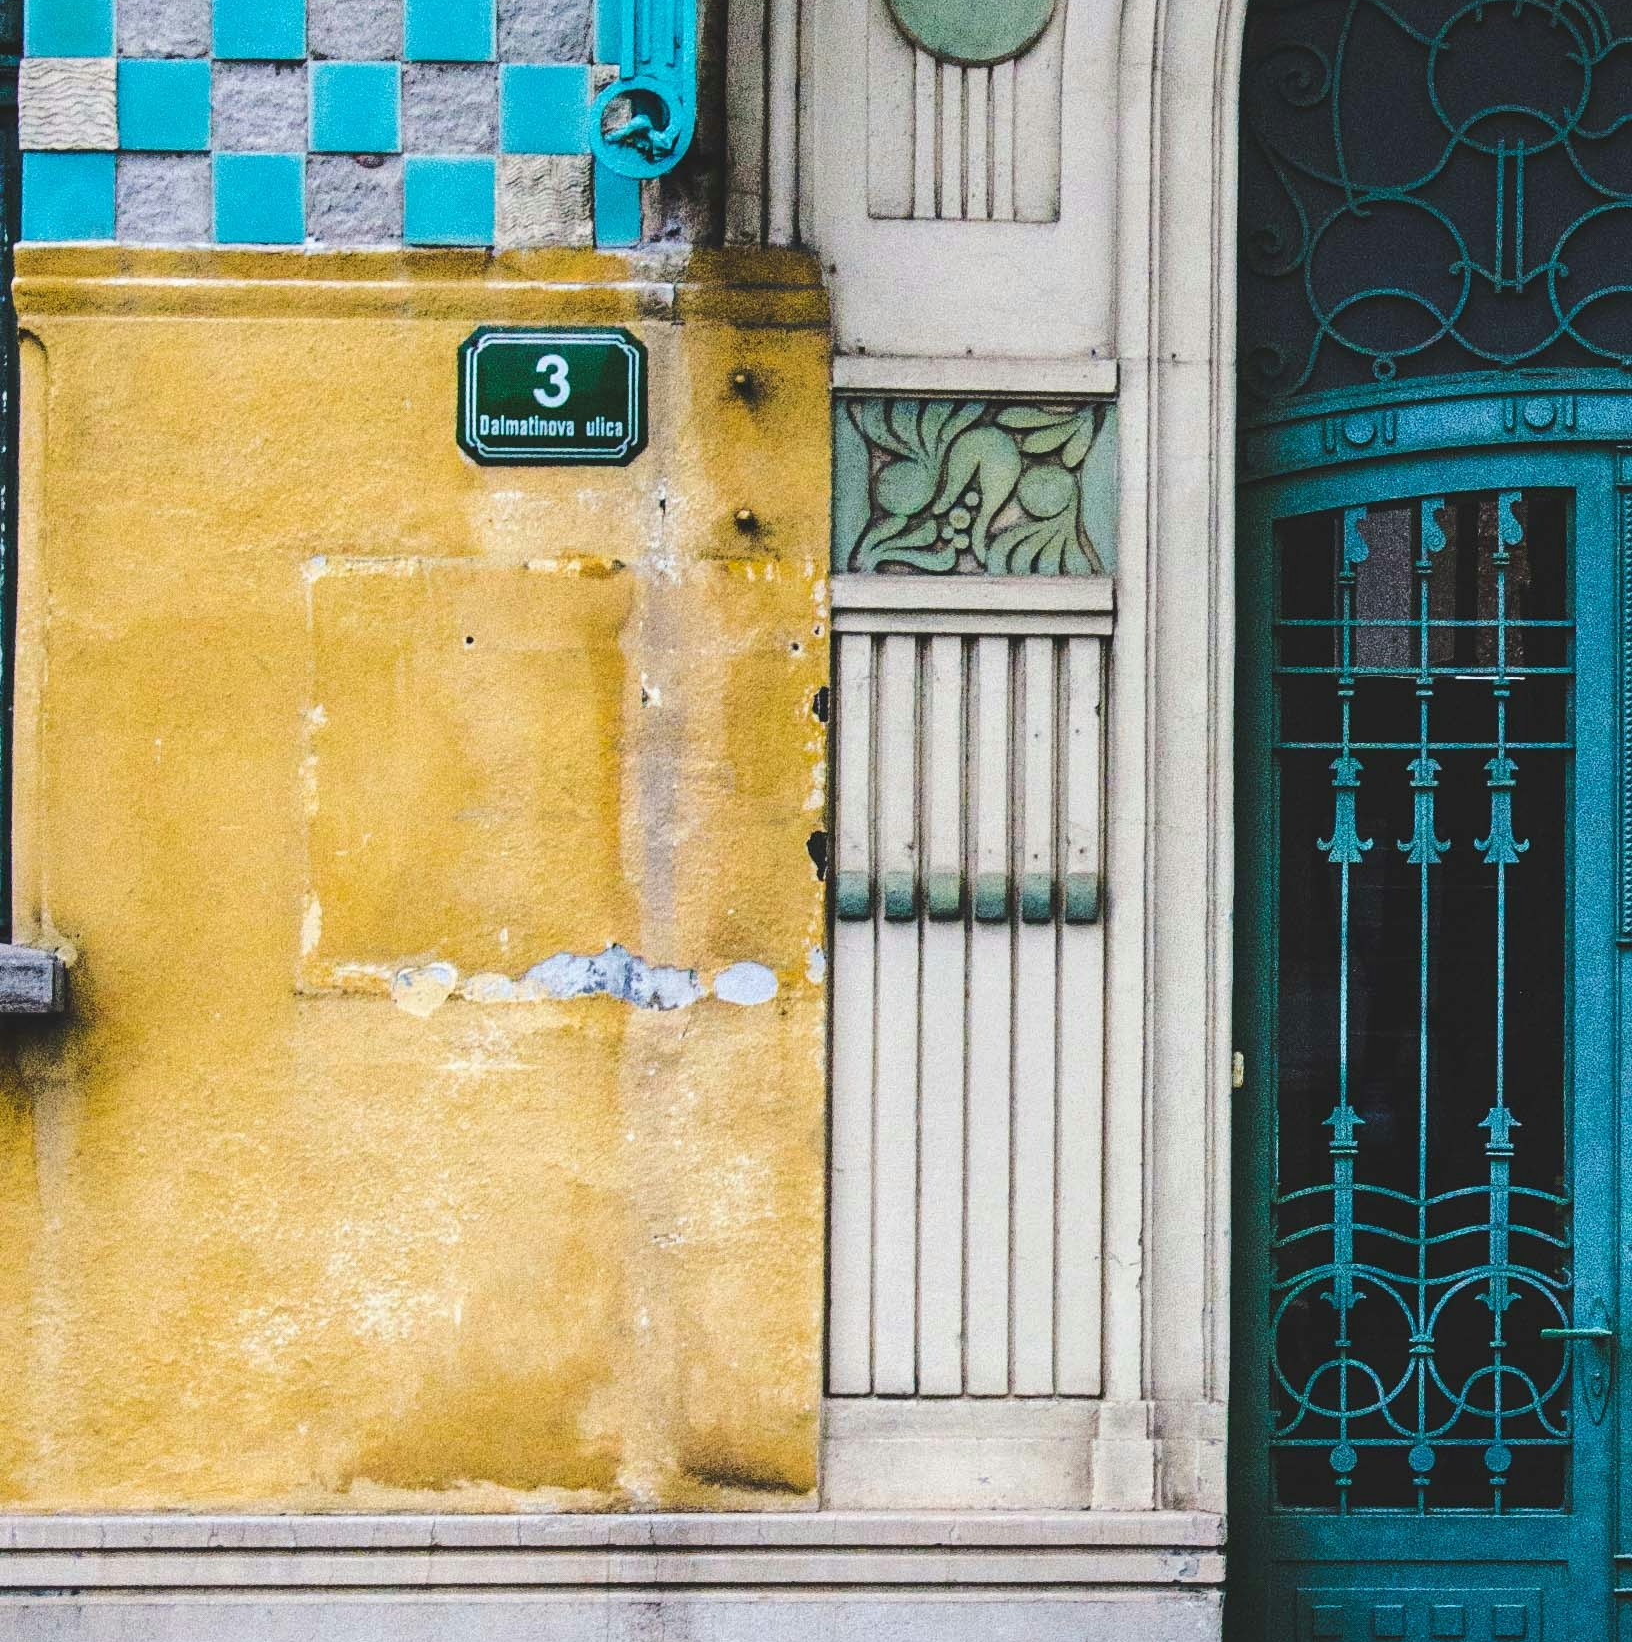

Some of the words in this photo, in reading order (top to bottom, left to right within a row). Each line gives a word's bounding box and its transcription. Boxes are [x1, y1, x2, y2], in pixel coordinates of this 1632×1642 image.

[533, 354, 571, 408] 3
[479, 415, 574, 437] Dalmatinova
[586, 416, 623, 437] ulica
